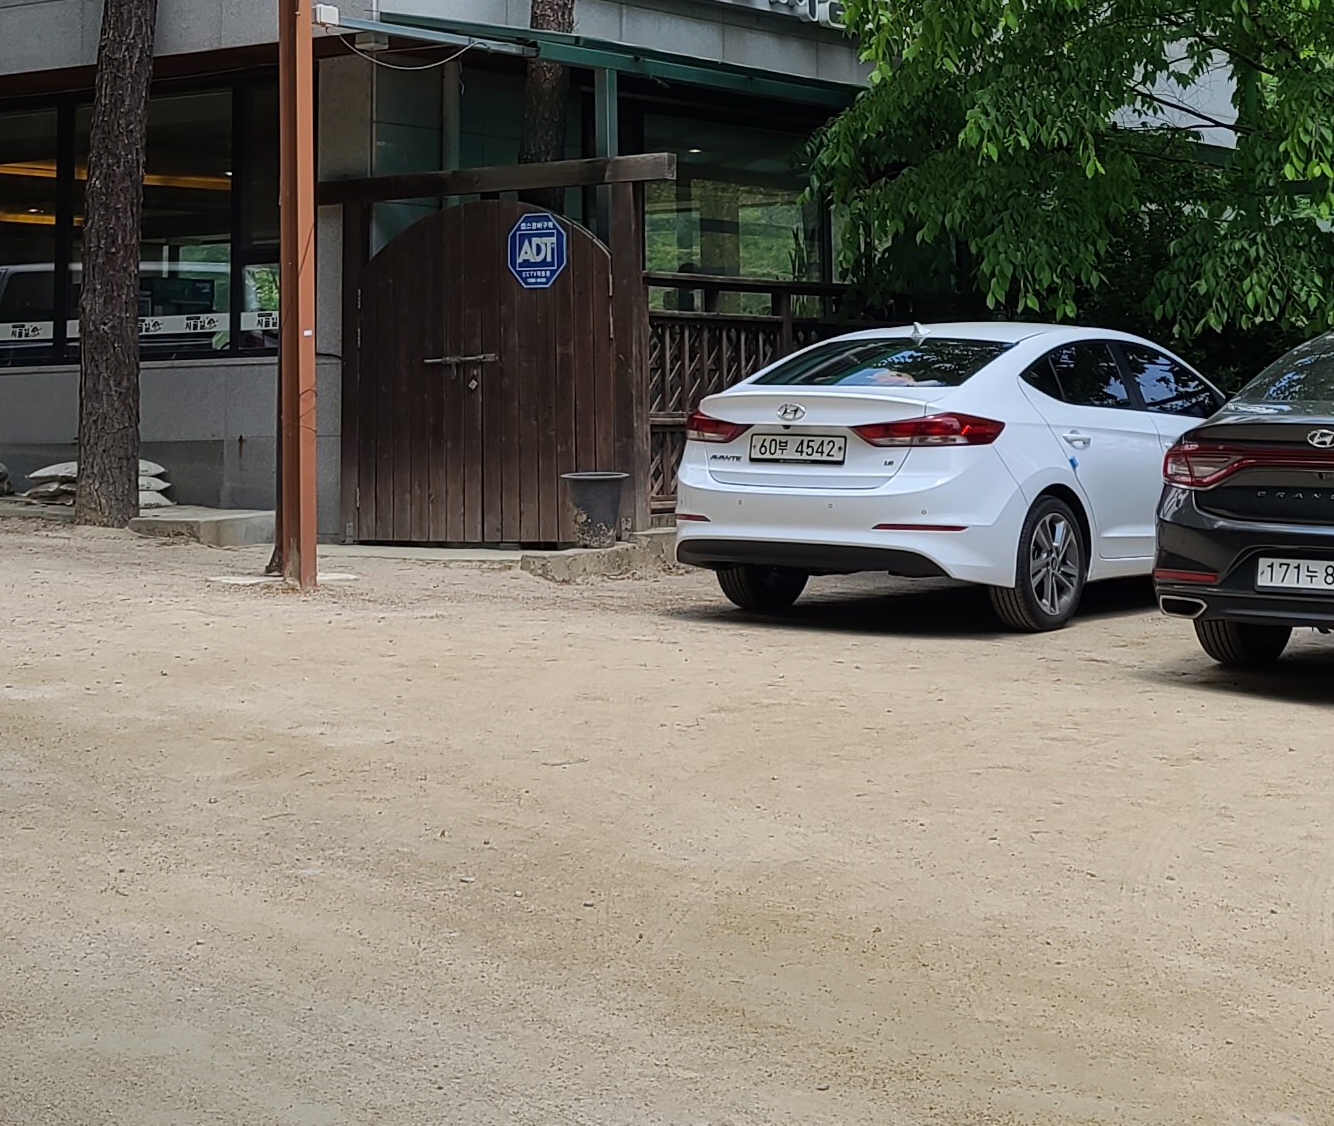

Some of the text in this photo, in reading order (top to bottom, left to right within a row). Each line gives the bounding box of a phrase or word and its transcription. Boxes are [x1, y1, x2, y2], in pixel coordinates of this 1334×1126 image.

[518, 236, 556, 263] ADT
[709, 453, 743, 463] AVANTE
[759, 438, 836, 458] 60부 4542
